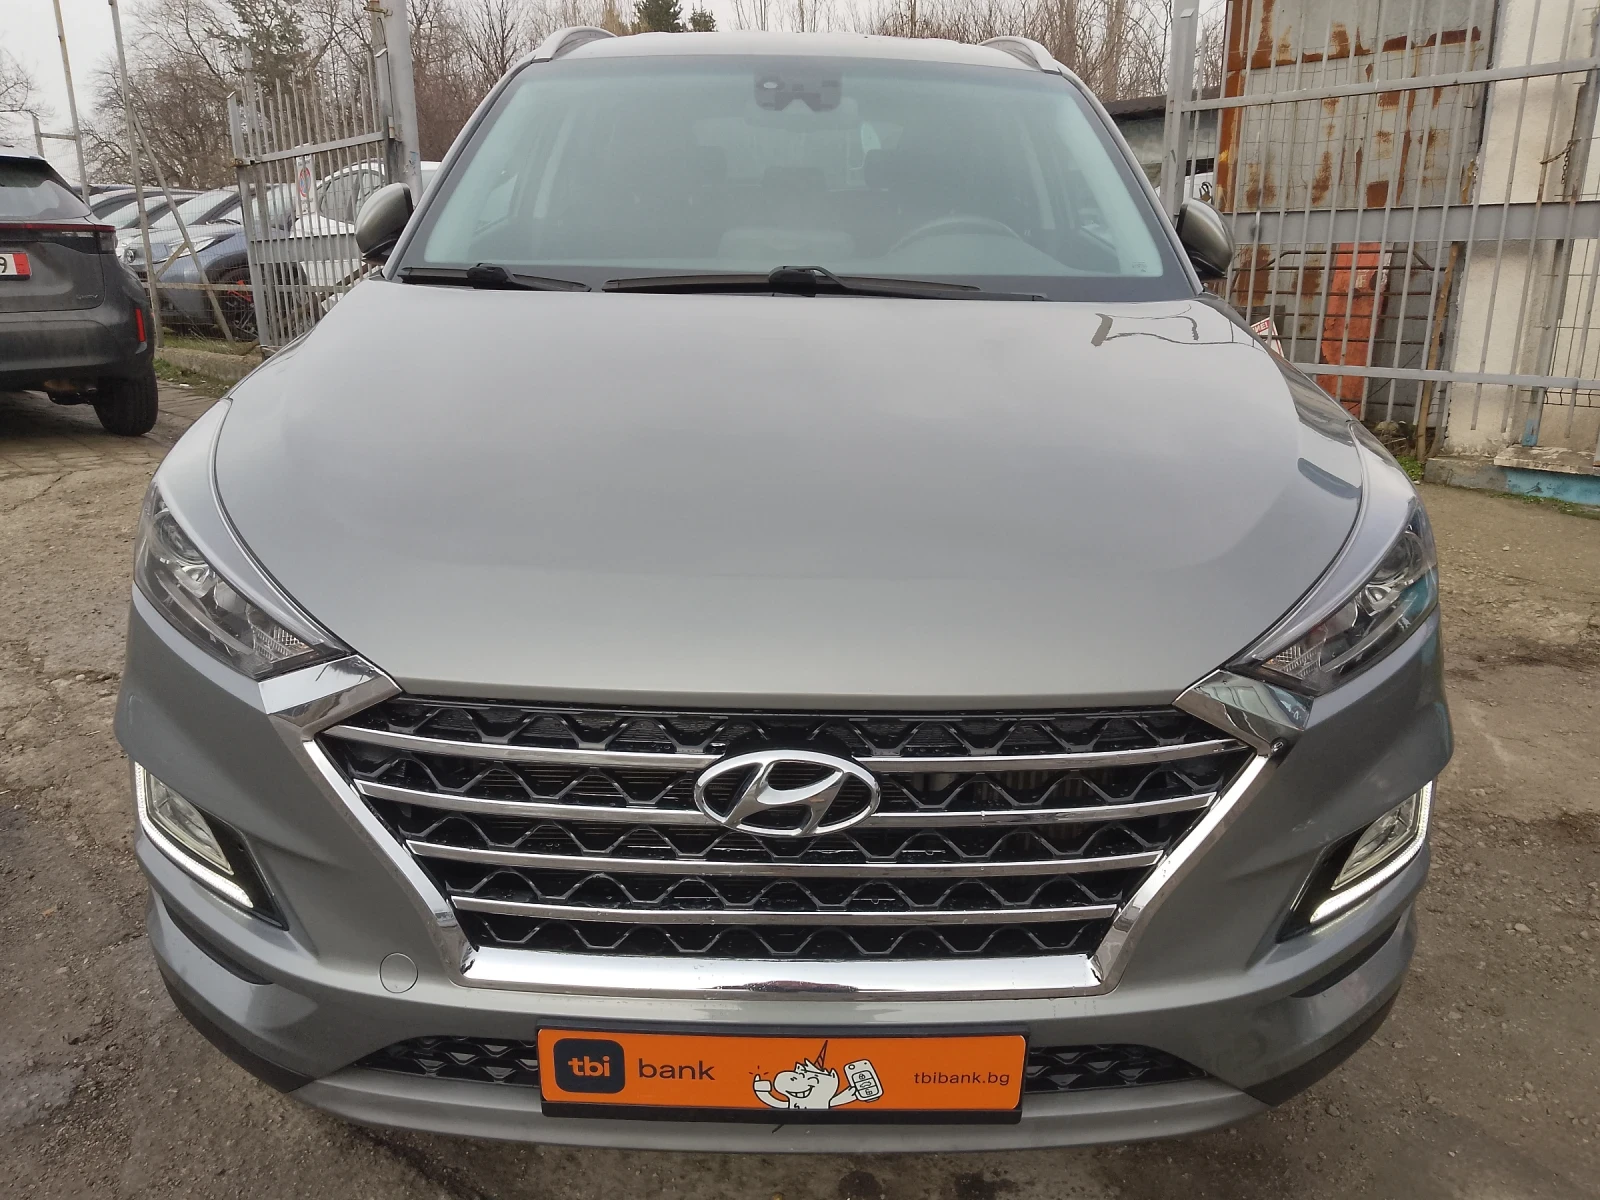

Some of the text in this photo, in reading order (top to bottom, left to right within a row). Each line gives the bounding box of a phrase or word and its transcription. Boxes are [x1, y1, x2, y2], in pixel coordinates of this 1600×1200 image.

[568, 1055, 716, 1081] tbi bank
[913, 1071, 1010, 1086] tbibank.bg
